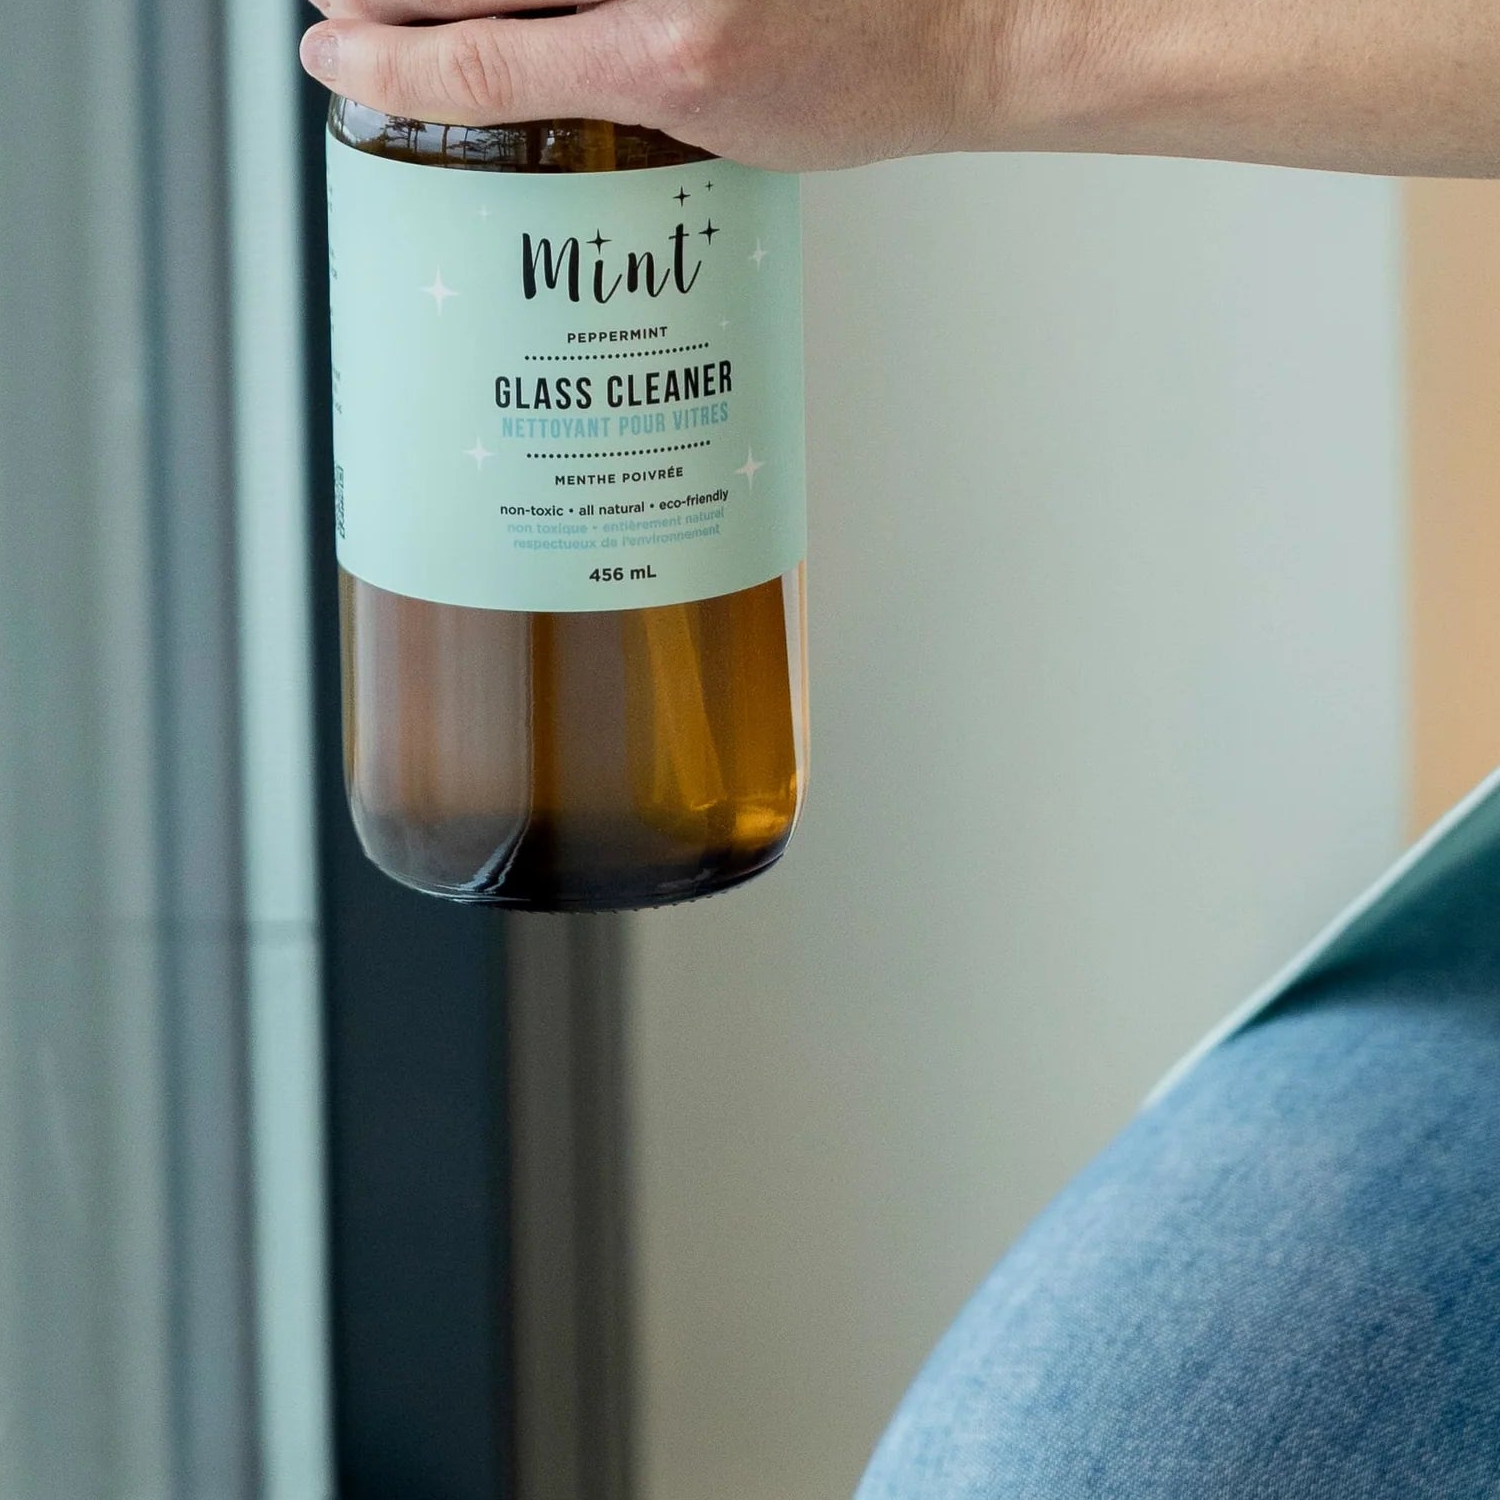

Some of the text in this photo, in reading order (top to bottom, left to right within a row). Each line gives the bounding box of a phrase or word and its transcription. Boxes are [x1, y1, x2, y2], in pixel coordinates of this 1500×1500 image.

[521, 222, 702, 304] Mint
[567, 326, 668, 344] PEPPERMINT
[495, 360, 733, 410] GLASS CLEANER
[501, 402, 729, 439] NETTOYANT POUR VITRES
[555, 466, 684, 486] MENTHE POIVRÉE
[500, 489, 729, 516] non-toxic all natural eco-friendly
[507, 523, 533, 533] non
[537, 521, 588, 536] toxique
[685, 506, 725, 525] naturel
[513, 538, 597, 551] respectueux
[601, 536, 618, 548] de
[589, 564, 657, 582] 456 mL
